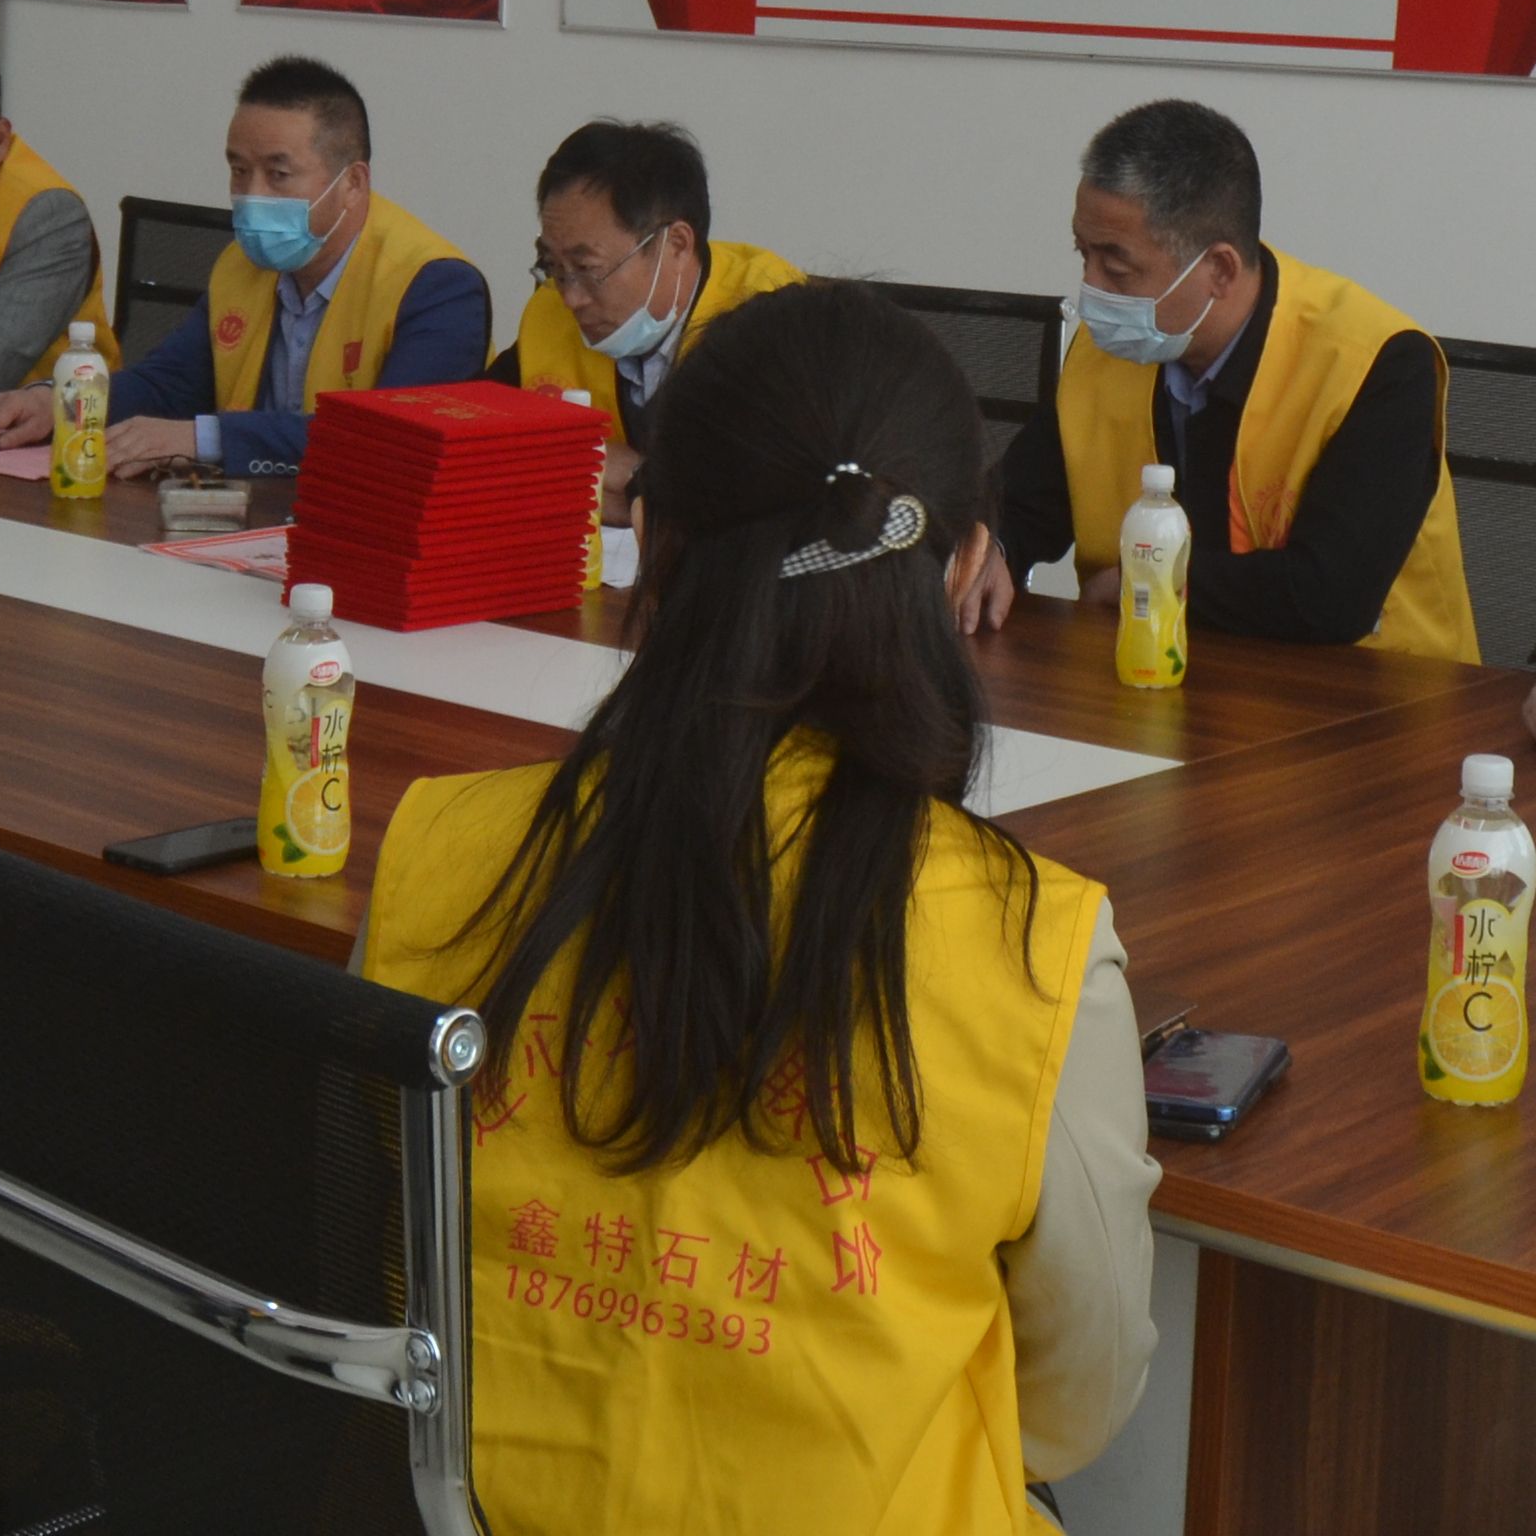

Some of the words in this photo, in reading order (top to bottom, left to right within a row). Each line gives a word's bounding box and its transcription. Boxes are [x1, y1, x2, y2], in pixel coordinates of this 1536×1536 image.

[1463, 907, 1496, 1032] 水柠C
[508, 1199, 789, 1304] 鑫特石材
[504, 1263, 772, 1356] 18769963393
